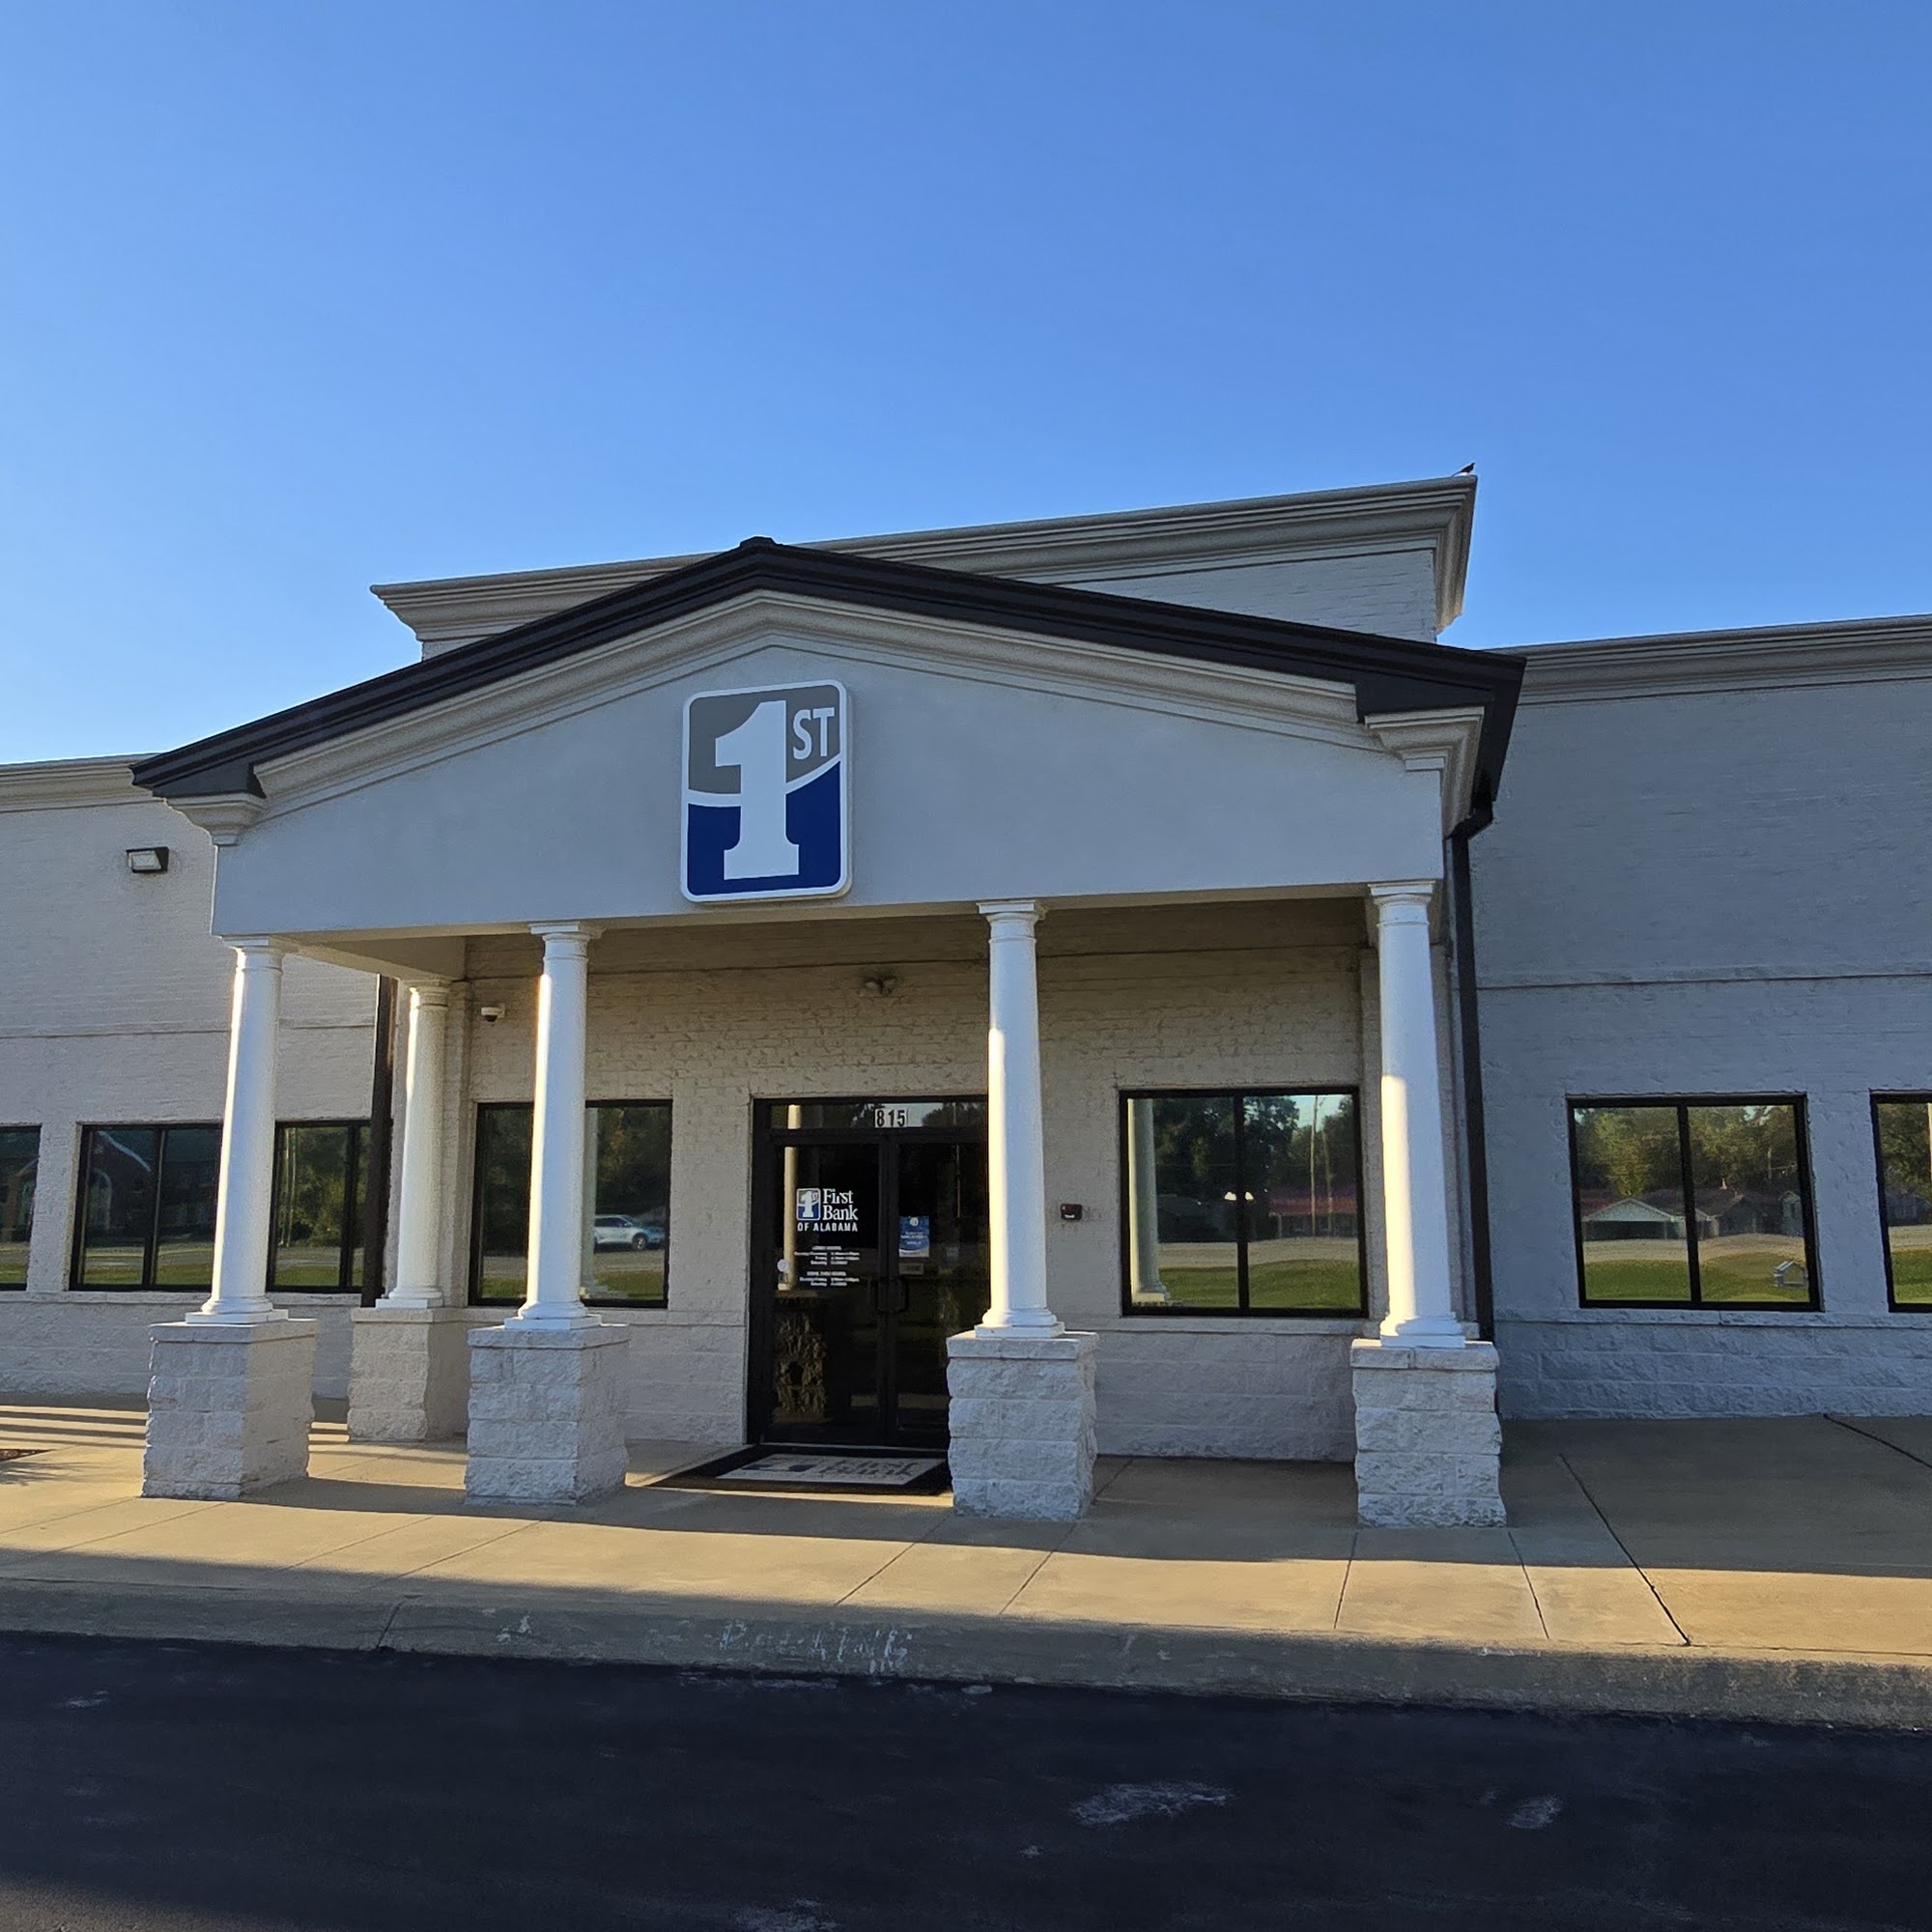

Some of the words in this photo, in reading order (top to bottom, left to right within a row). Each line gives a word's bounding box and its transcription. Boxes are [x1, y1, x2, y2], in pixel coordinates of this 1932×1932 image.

[876, 1109, 906, 1127] 815
[822, 1188, 854, 1204] First
[822, 1205, 859, 1221] Bank
[797, 1222, 810, 1232] OF
[812, 1222, 858, 1232] ALABAMA
